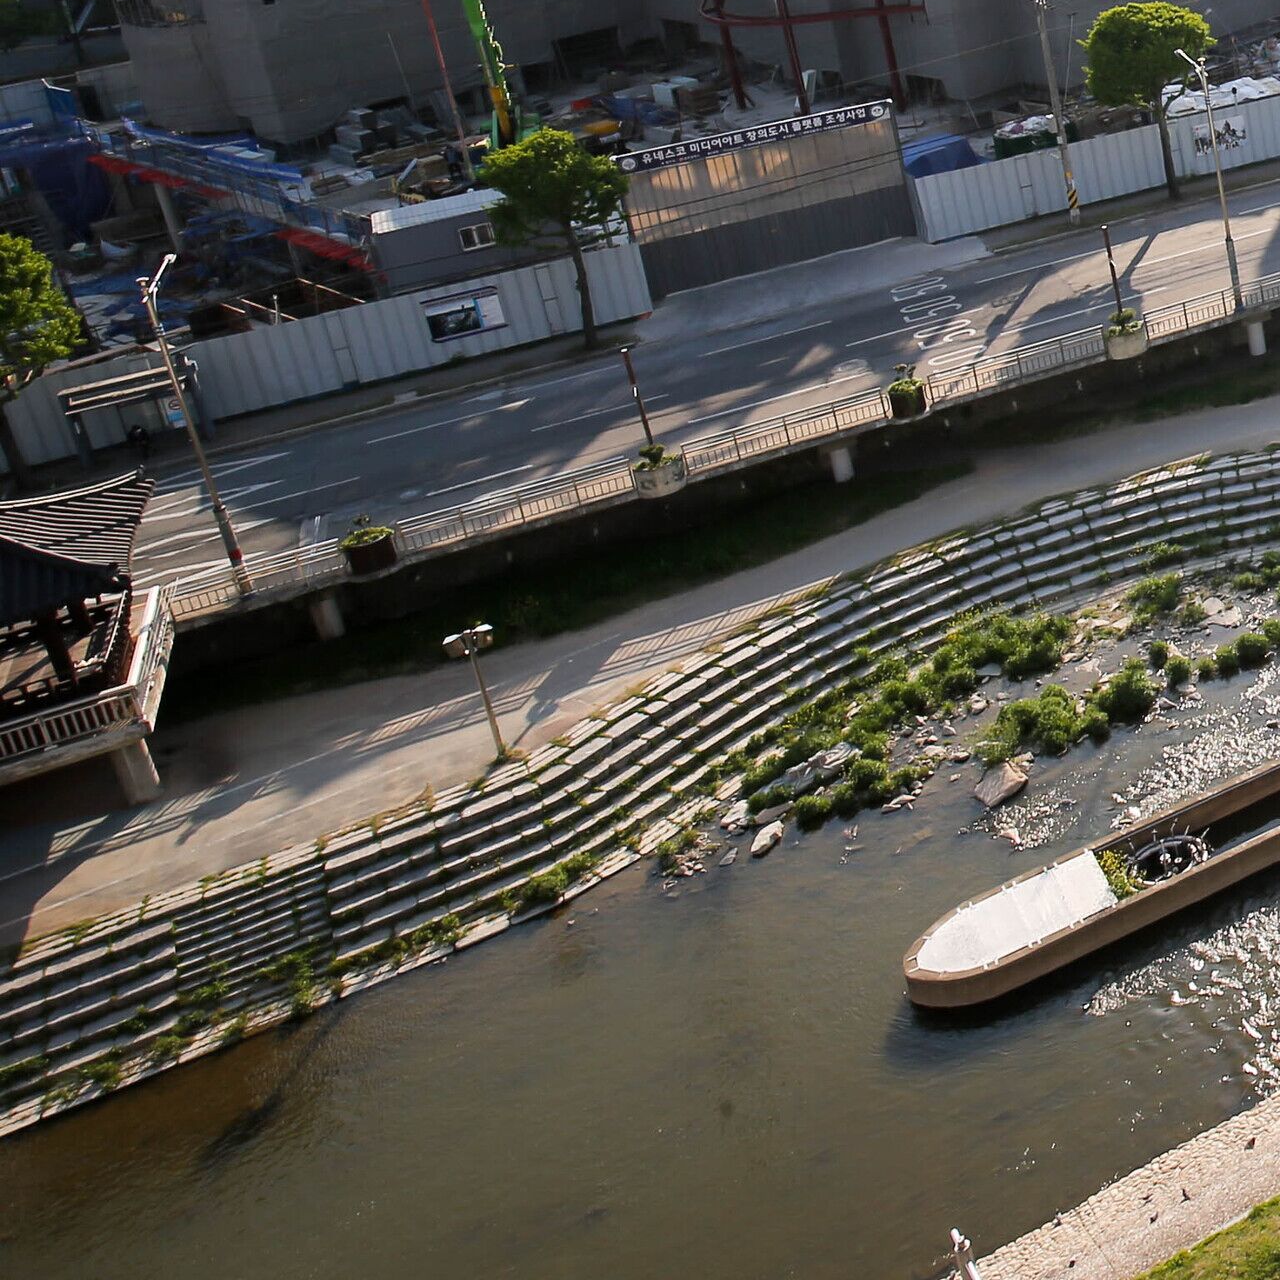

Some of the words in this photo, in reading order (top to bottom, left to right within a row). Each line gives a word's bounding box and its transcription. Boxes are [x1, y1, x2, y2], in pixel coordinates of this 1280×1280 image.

[641, 146, 687, 164] 유네스코
[689, 134, 745, 153] 미디어아트
[745, 124, 789, 141] 창의도시
[826, 108, 866, 125] 조성사업
